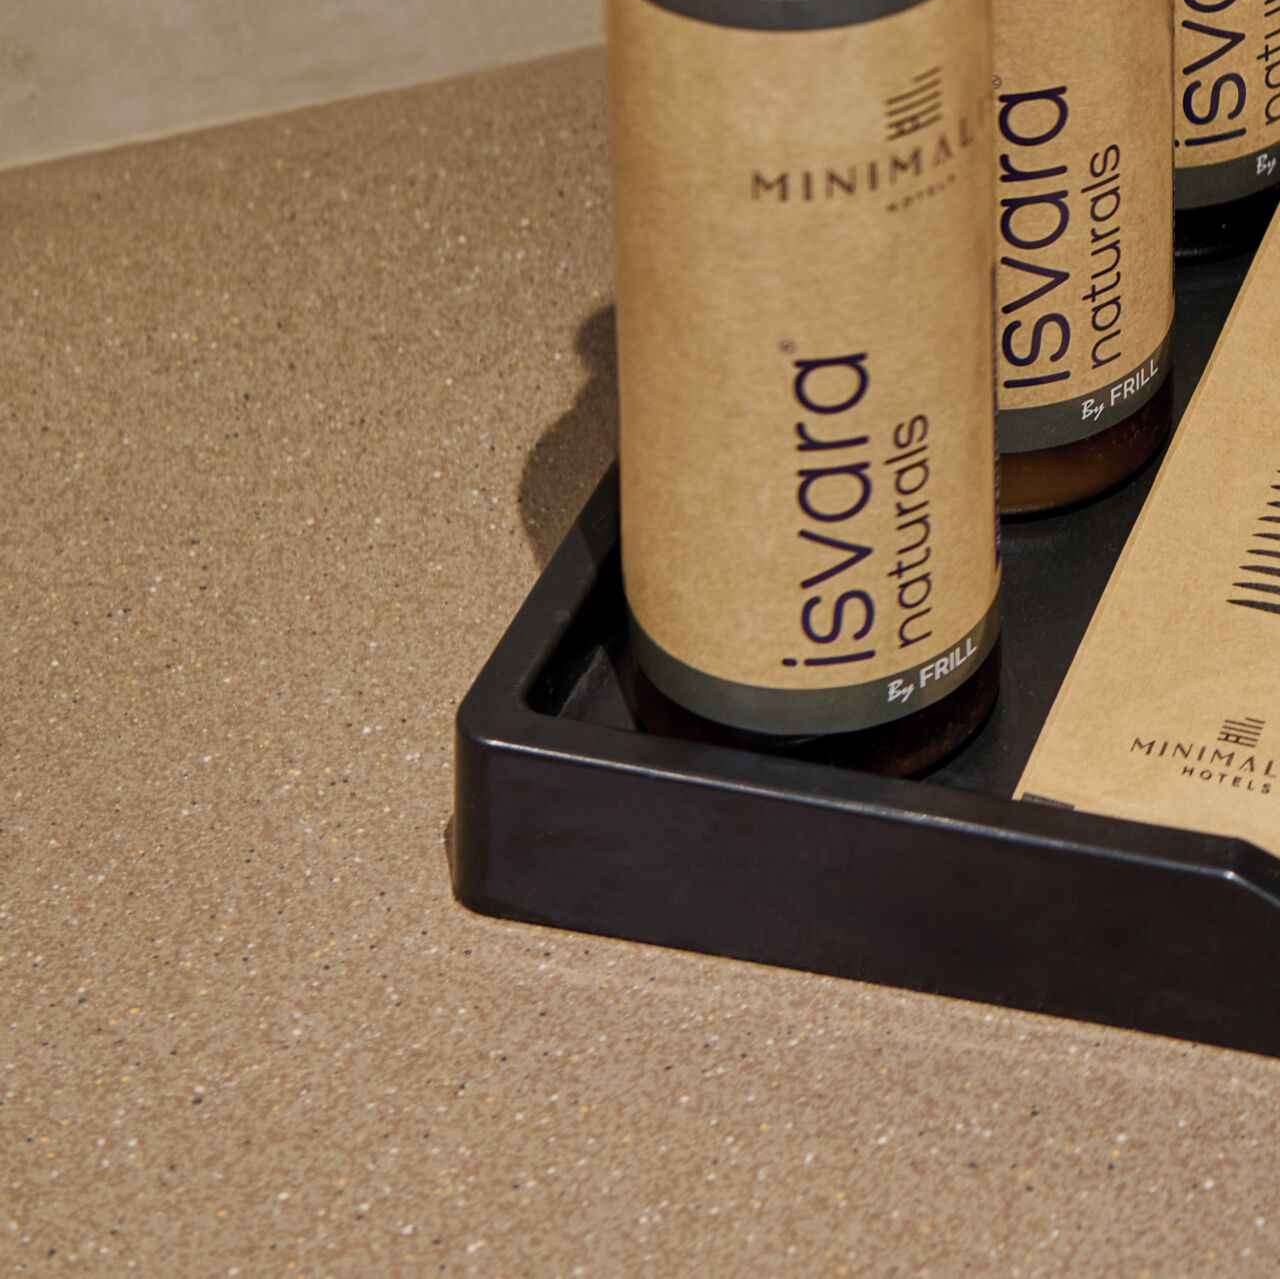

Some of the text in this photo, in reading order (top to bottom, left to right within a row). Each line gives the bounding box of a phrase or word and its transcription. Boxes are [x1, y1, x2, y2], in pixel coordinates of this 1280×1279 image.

[1256, 153, 1277, 176] By
[1080, 143, 1122, 370] naturals
[1081, 358, 1159, 421] By FRILL
[781, 351, 877, 669] isvara
[884, 413, 933, 650] naturals
[886, 637, 978, 705] By FRILL
[1182, 766, 1272, 795] HOTELS
